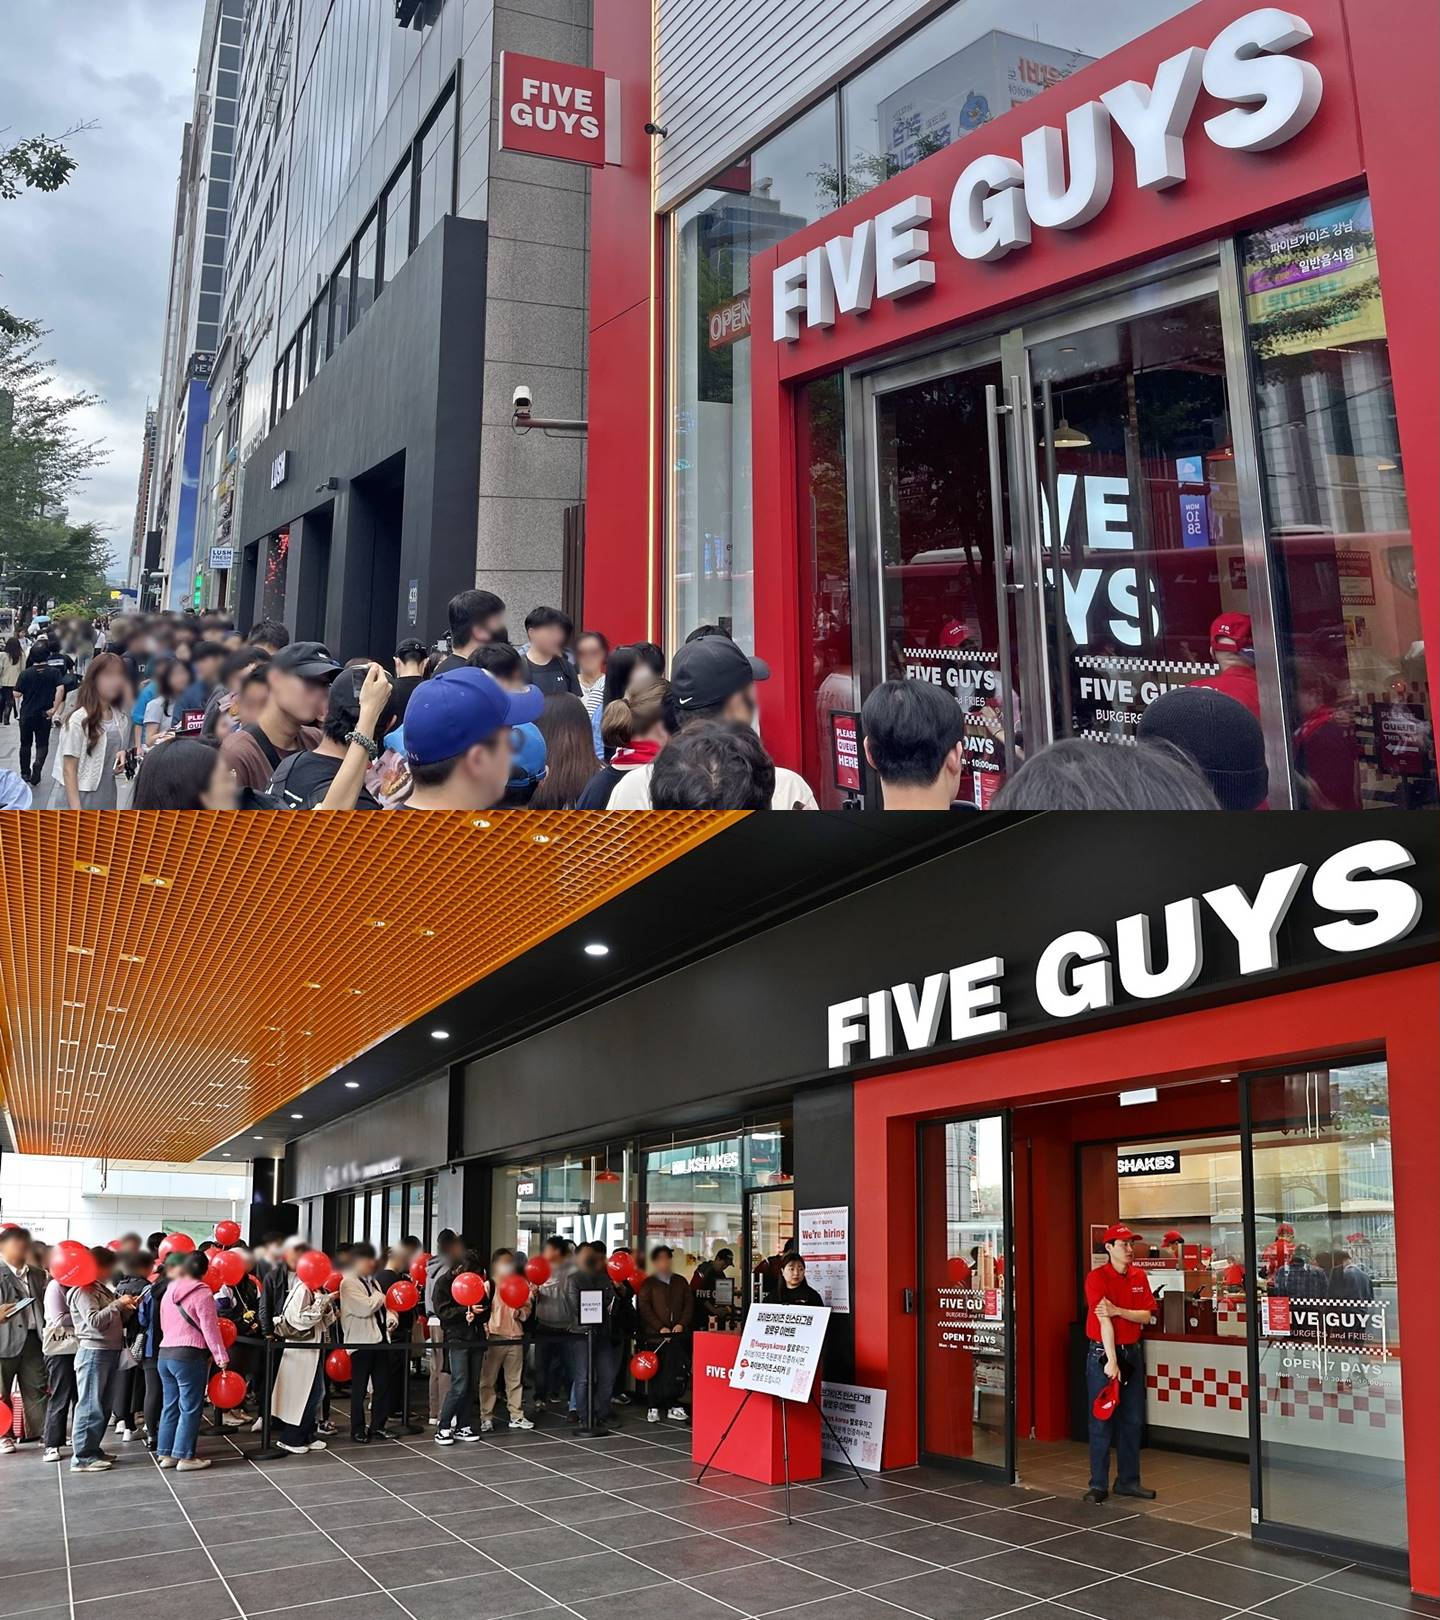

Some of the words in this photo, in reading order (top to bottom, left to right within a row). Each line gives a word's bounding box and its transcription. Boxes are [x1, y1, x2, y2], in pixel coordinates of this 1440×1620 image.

[522, 77, 592, 112] FIVE
[510, 102, 600, 139] GUYS
[773, 195, 935, 343] FIVE
[950, 7, 1323, 260] GUYS
[1270, 227, 1330, 254] 파이브가이즈
[1333, 219, 1354, 237] 강남
[1299, 246, 1355, 273] 일반음식점
[711, 300, 751, 341] OPEN
[1041, 474, 1134, 549] VE
[946, 667, 996, 691] GUYS
[1080, 677, 1134, 703] FIVE
[963, 695, 986, 706] FRIES
[1096, 709, 1143, 724] BURGERS
[836, 728, 857, 739] PLEASE
[838, 740, 857, 753] QUEUE
[838, 755, 859, 769] HERE
[828, 956, 1008, 1069] FIVE
[1035, 839, 1423, 1018] GUYS
[1117, 1155, 1175, 1173] SHAKES
[556, 1212, 626, 1256] FIVE
[802, 1229, 821, 1239] We're
[823, 1228, 845, 1239] hiring
[940, 1298, 964, 1309] FIVE
[966, 1299, 985, 1310] GU
[1325, 1312, 1385, 1329] GUYS
[943, 1333, 964, 1341] OPEN
[966, 1334, 971, 1342] 7
[973, 1335, 996, 1344] DAYS
[1330, 1331, 1345, 1339] and
[1348, 1332, 1374, 1340] FRIES
[706, 1366, 726, 1379] FIVE
[1282, 1357, 1320, 1369] OPEN
[1327, 1361, 1335, 1371] 7
[1341, 1362, 1382, 1375] DAYS
